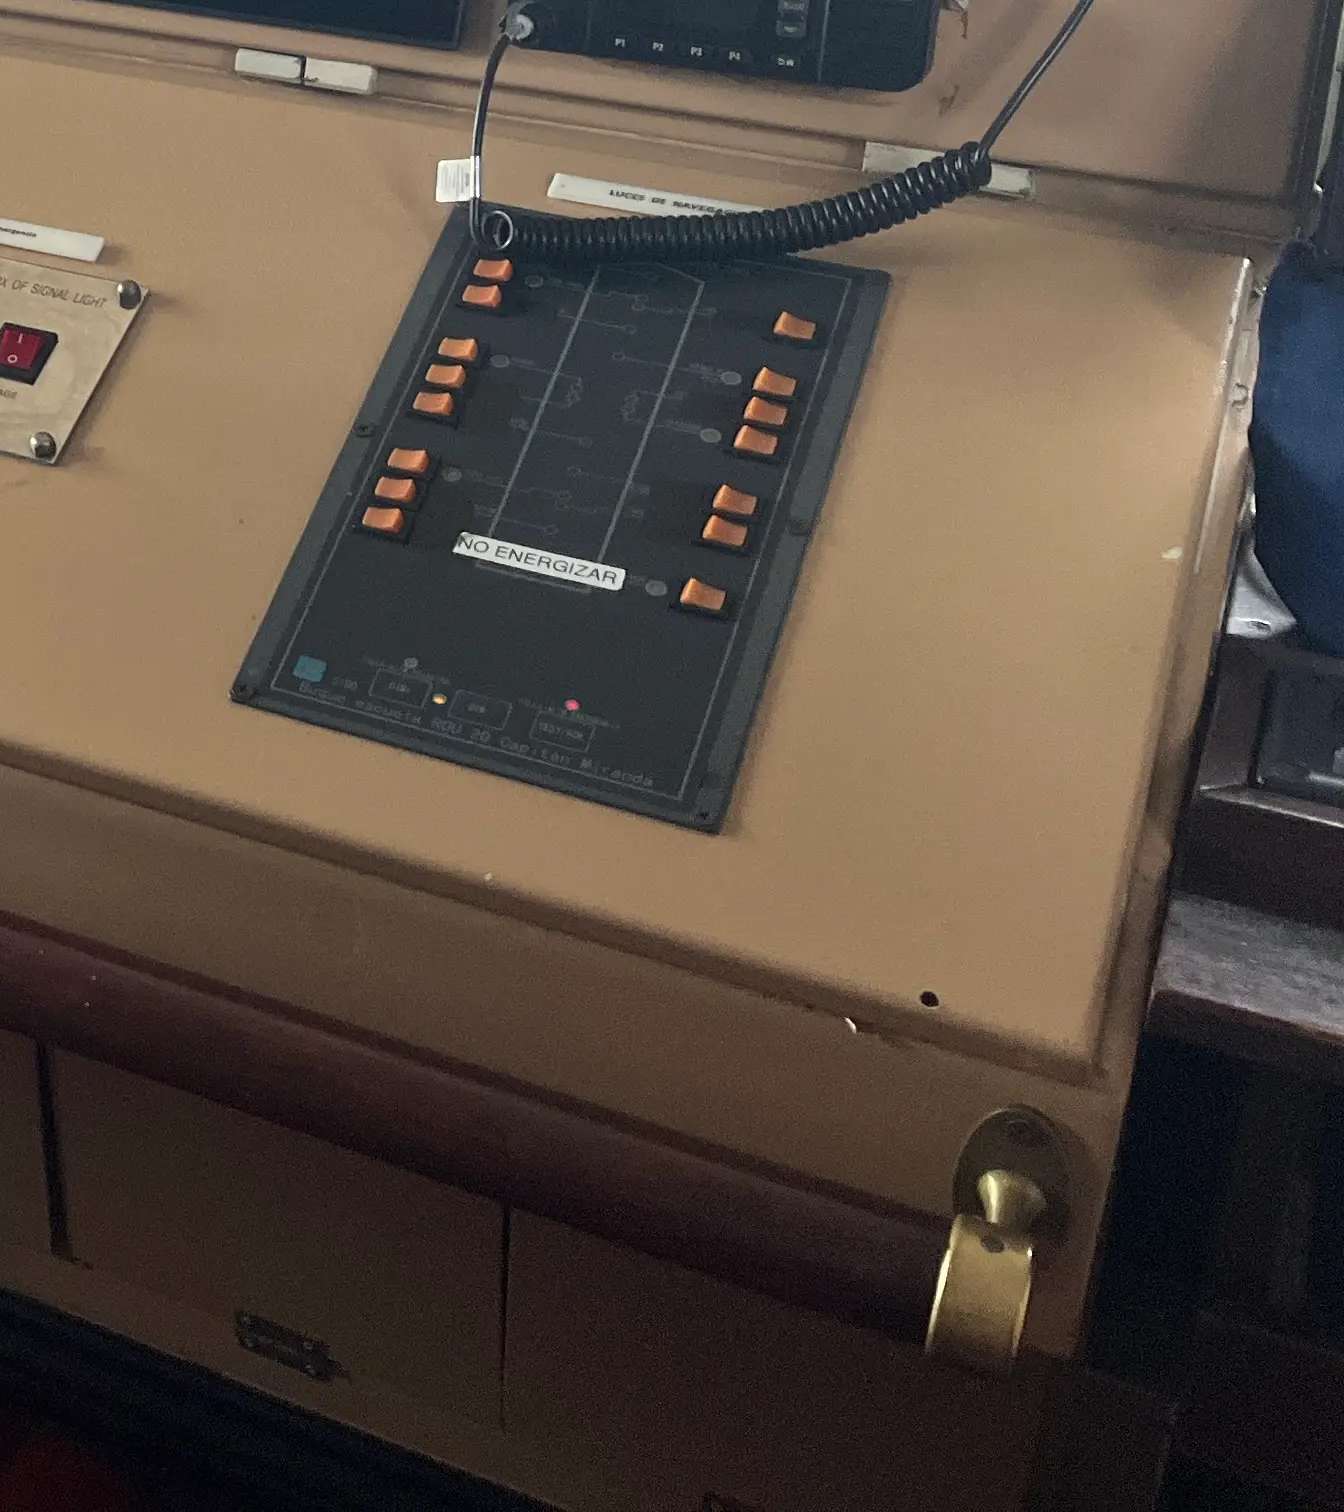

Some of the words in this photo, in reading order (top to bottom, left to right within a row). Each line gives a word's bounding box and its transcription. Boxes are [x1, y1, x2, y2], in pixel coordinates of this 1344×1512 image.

[652, 42, 664, 52] P2
[690, 46, 702, 56] P3
[11, 279, 31, 292] OF
[31, 283, 72, 302] SIGNAL
[72, 292, 109, 308] LIGHT
[457, 538, 490, 554] NO
[494, 544, 618, 585] ENERGIZAR
